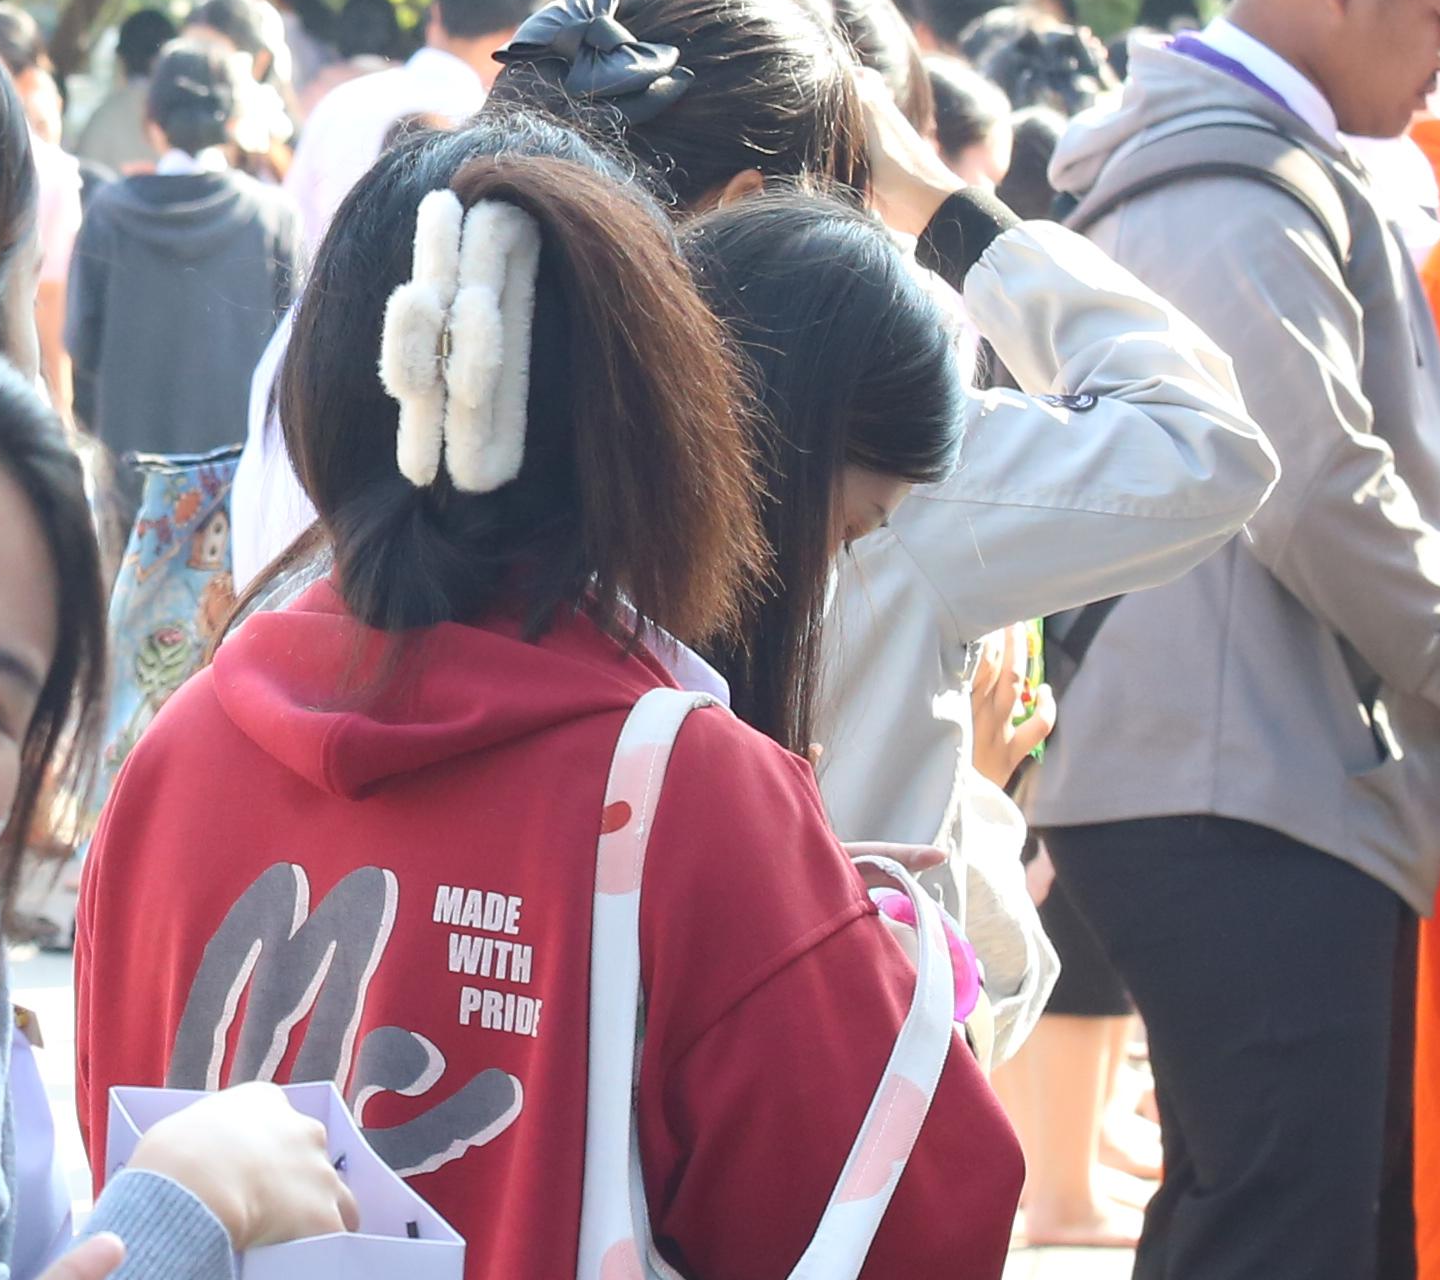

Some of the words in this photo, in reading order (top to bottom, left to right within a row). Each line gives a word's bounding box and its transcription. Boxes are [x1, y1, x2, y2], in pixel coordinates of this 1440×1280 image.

[433, 885, 524, 936] MADE
[448, 933, 533, 985] WITH
[458, 989, 543, 1039] PRIDE
